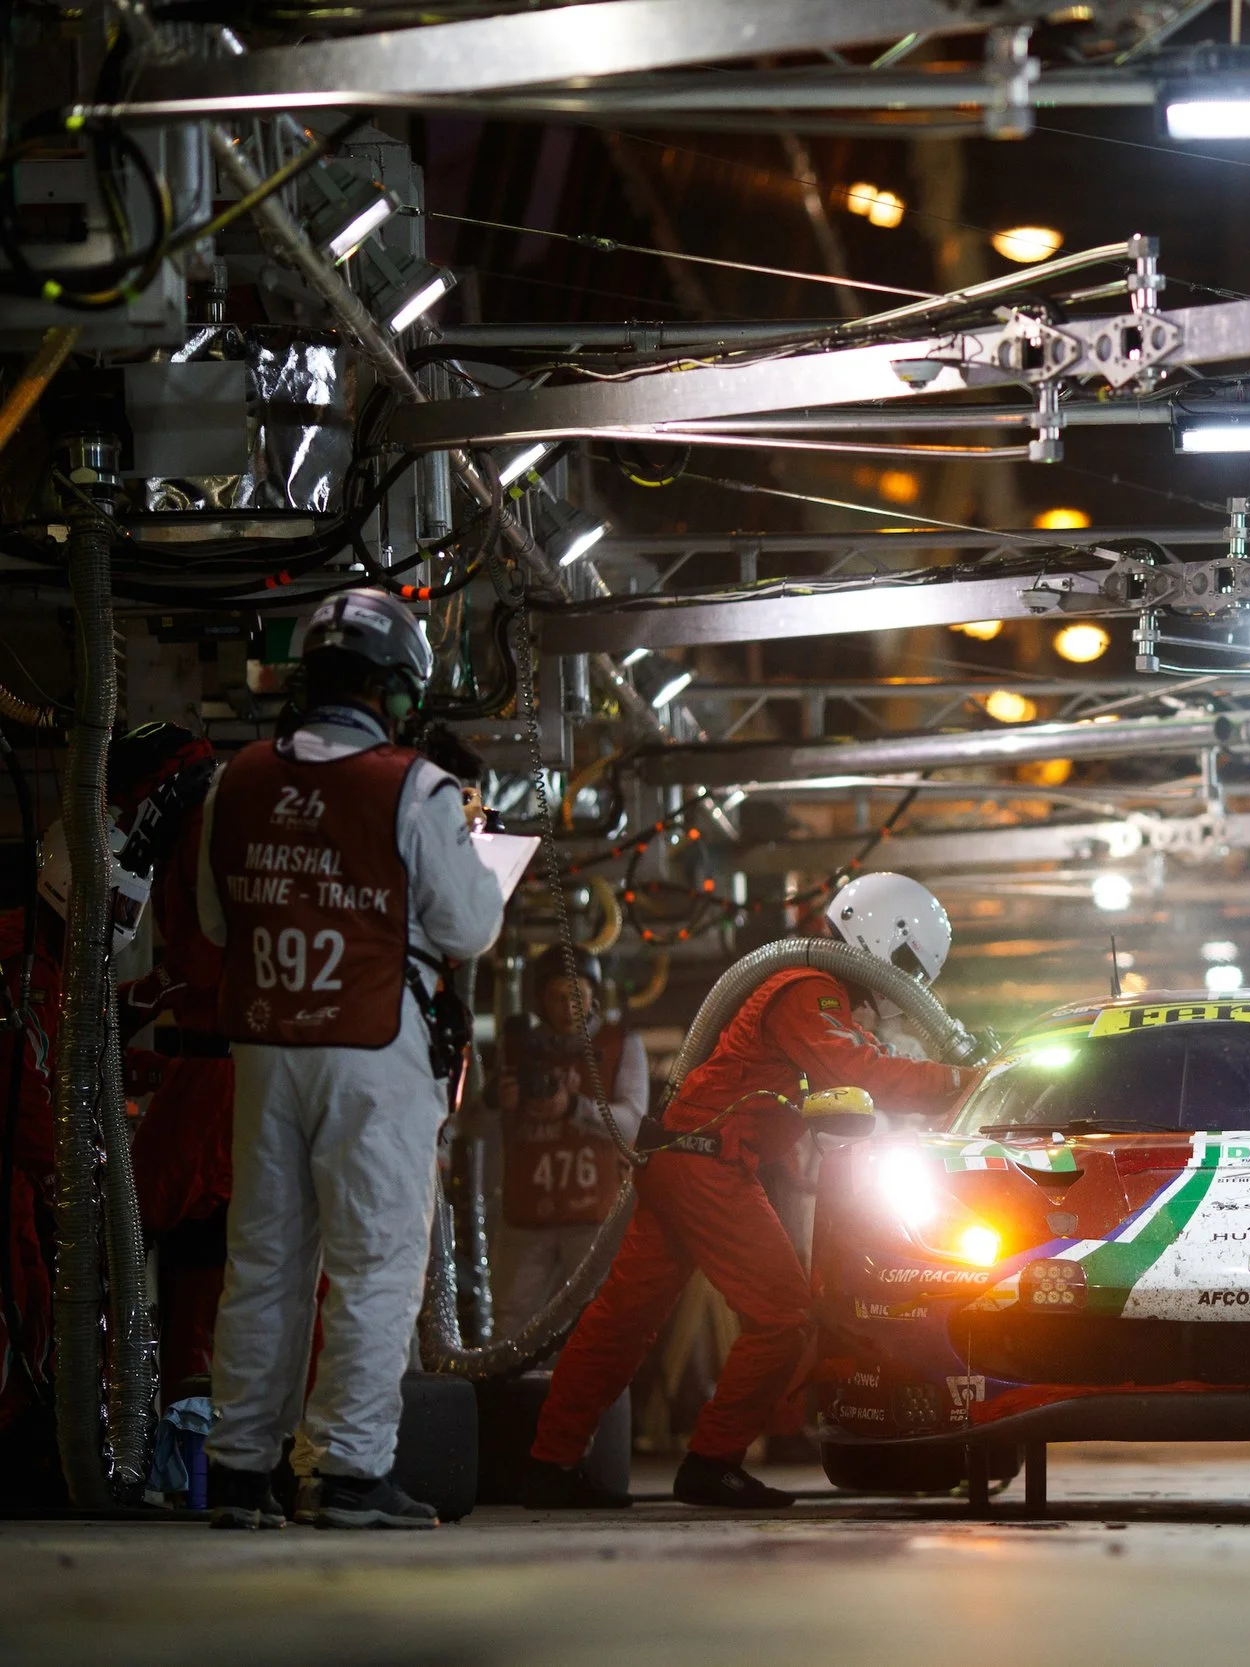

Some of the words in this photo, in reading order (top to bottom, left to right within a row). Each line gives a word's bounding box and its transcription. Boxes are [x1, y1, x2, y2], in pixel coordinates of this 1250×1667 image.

[244, 842, 344, 877] MARSHAL
[316, 881, 391, 914] TRACK
[533, 1146, 598, 1192] 476
[884, 1268, 919, 1283] SMP
[919, 1270, 990, 1284] RACING
